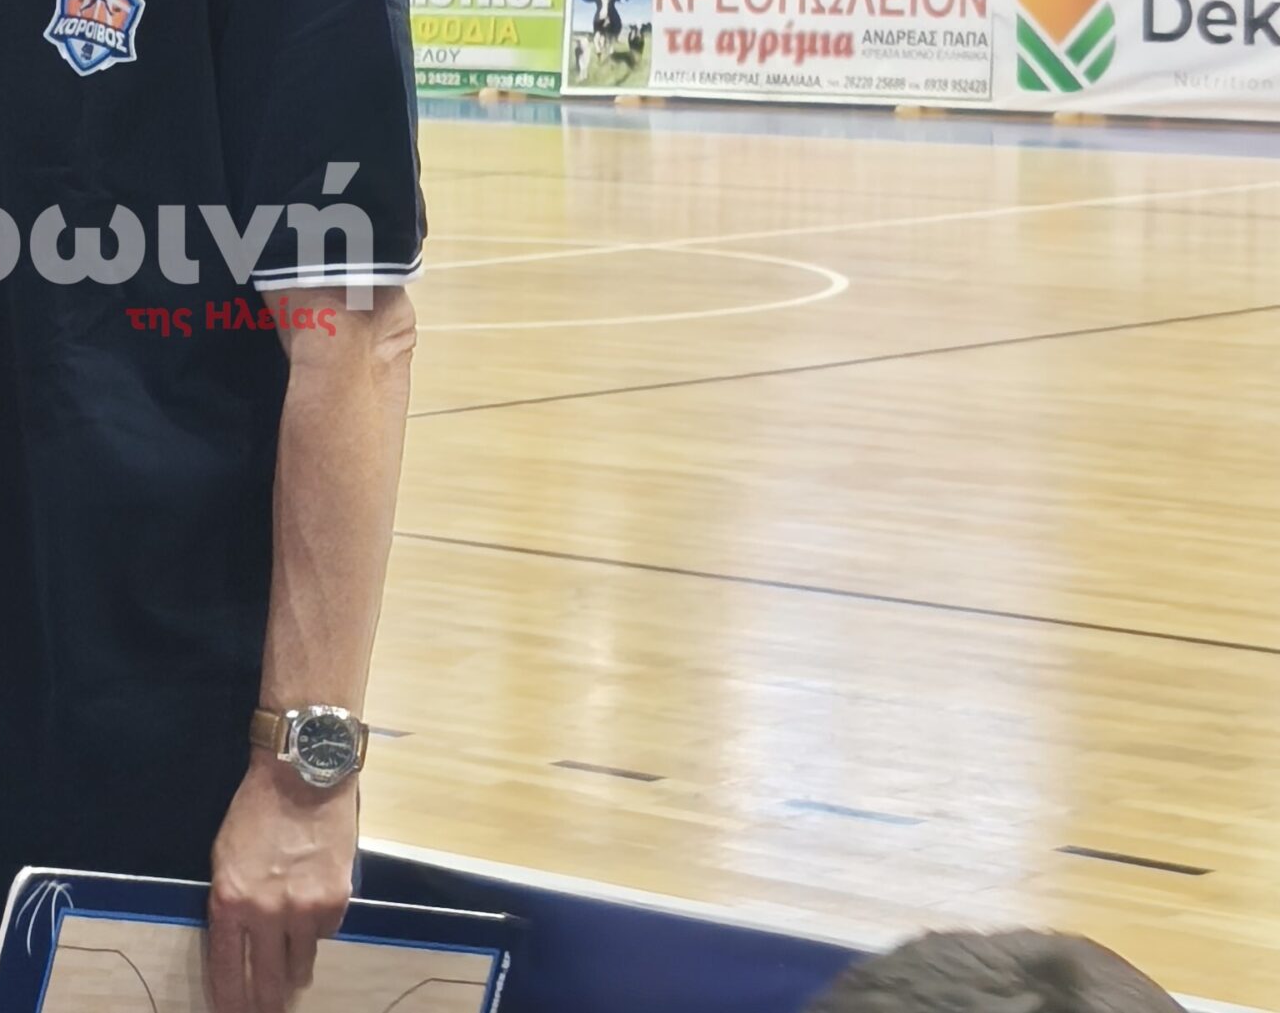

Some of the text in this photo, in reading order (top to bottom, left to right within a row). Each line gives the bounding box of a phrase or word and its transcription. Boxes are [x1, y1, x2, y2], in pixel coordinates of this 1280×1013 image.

[53, 17, 128, 54] ΚΟΡΟΙΒΟΣ
[665, 28, 704, 55] τα
[861, 29, 988, 47] ΑΝΔΡΕΑΣ ΠΑΠΑ
